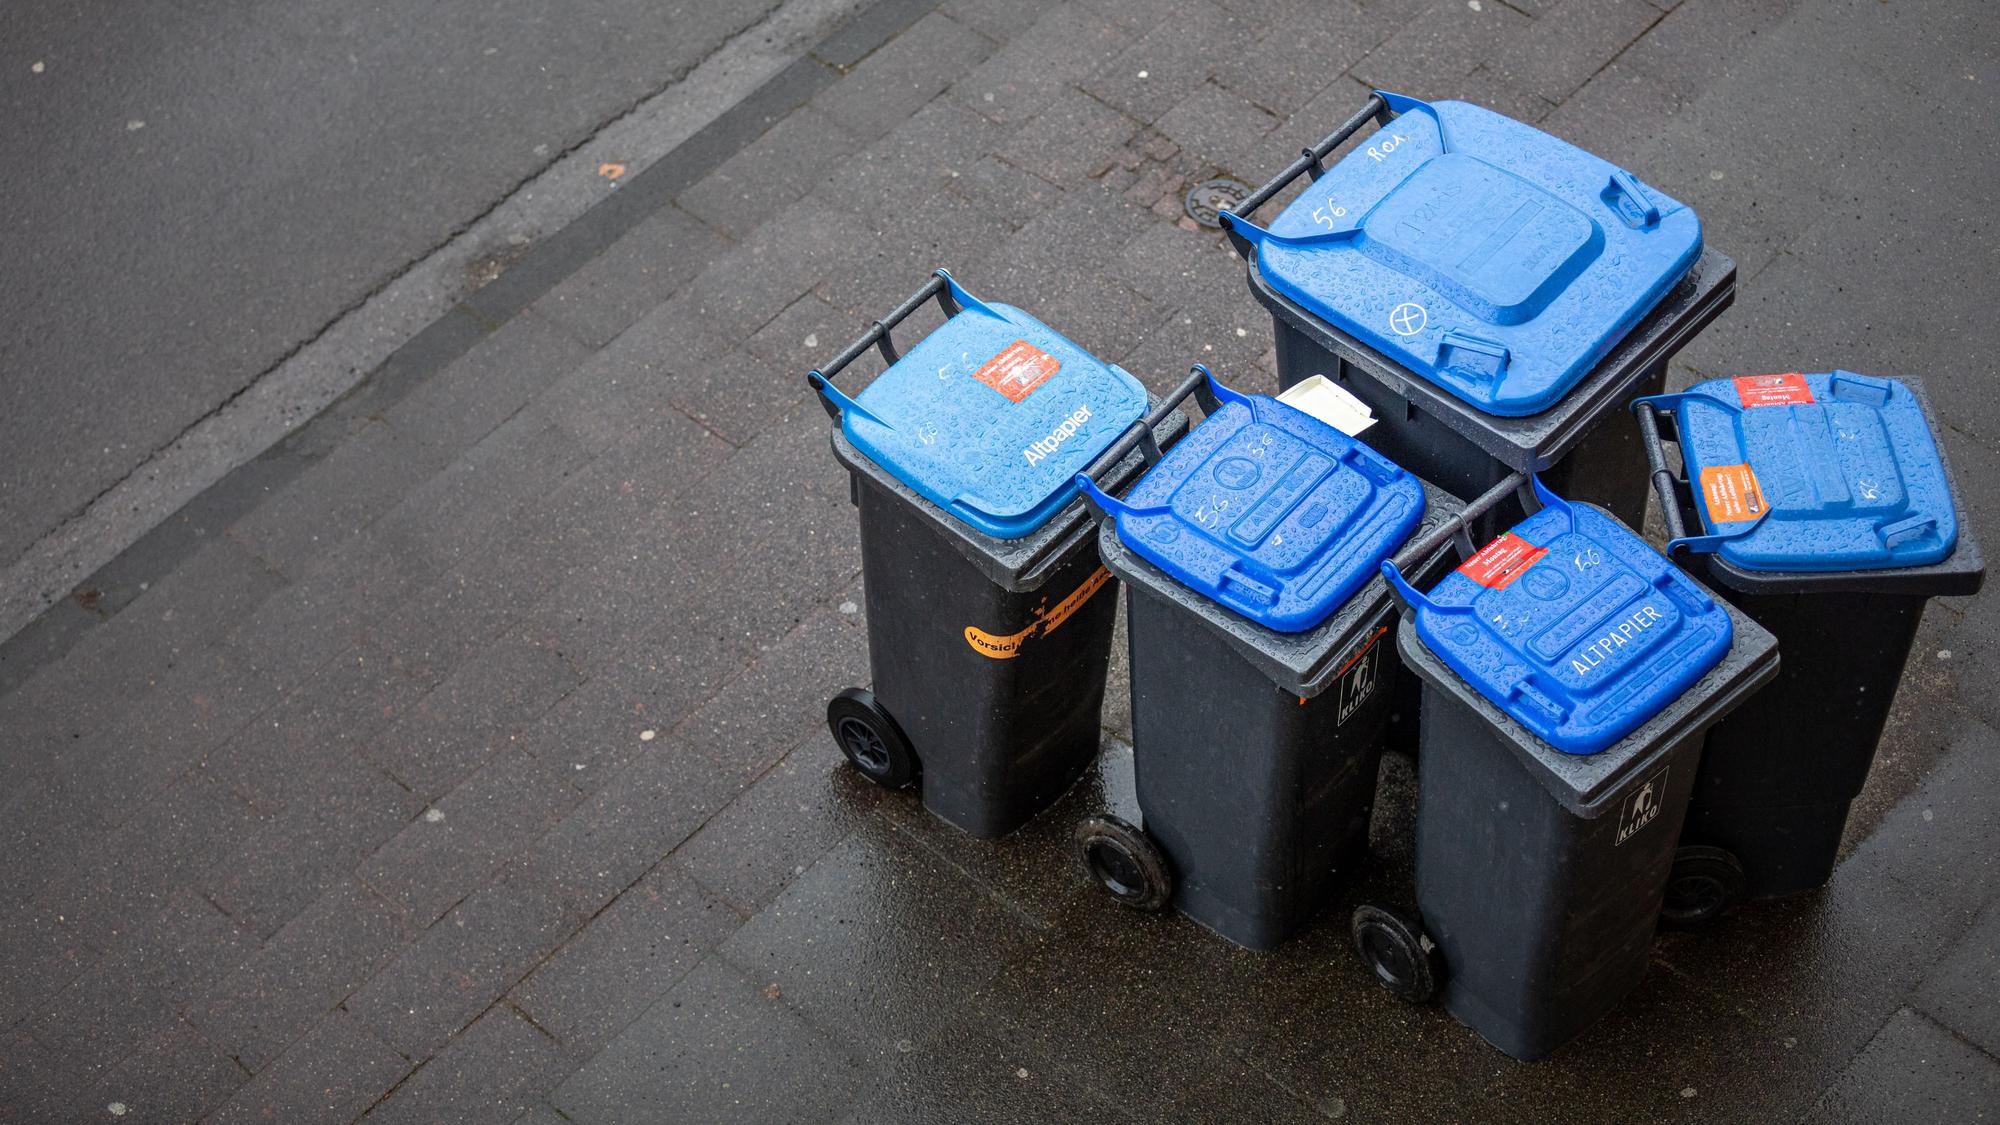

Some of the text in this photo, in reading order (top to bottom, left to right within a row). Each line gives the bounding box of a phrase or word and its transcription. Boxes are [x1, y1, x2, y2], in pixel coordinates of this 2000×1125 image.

[1312, 197, 1346, 230] 56
[1023, 404, 1093, 467] Altpapier
[1194, 494, 1228, 529] 56
[1482, 547, 1507, 567] Montag
[1574, 549, 1600, 572] 56
[1571, 606, 1663, 676] ALTPAPIER
[1341, 680, 1373, 720] KLIKO
[1619, 804, 1658, 841] KLIKO
